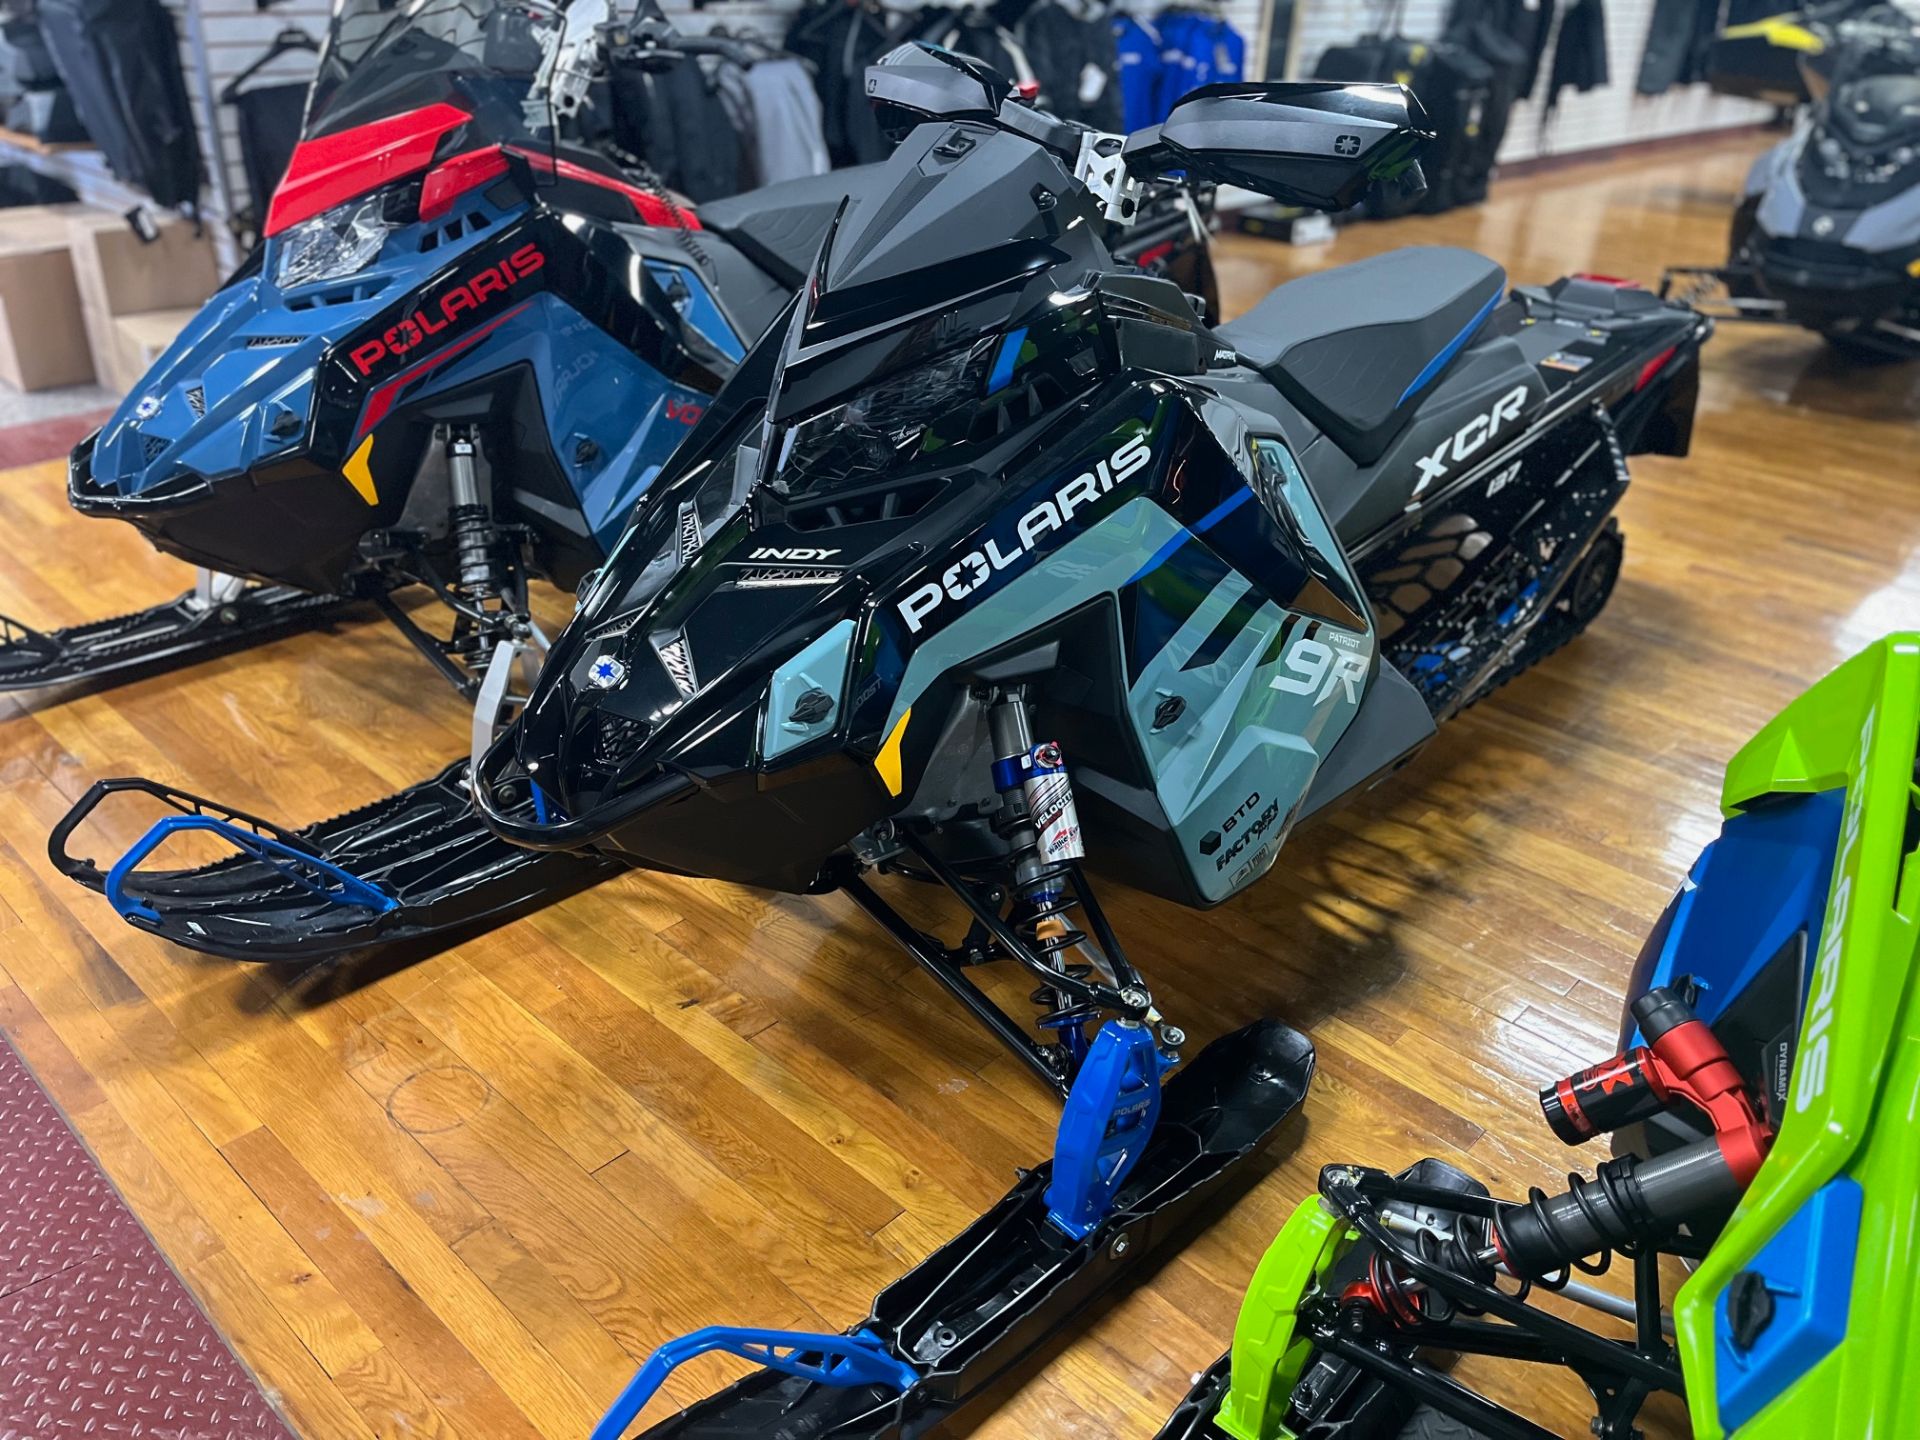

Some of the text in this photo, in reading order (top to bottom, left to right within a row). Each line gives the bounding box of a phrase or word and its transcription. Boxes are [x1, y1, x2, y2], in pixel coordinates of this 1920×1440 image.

[350, 242, 545, 376] POLARIS
[1411, 385, 1528, 497] XCR
[748, 547, 842, 560] INDY
[896, 433, 1152, 634] POLARIS
[1268, 638, 1371, 707] 9R
[1328, 631, 1361, 648] PATRIOT
[1215, 797, 1279, 872] FACTORY
[1222, 791, 1261, 834] BTD
[1796, 703, 1876, 1113] POLARIS
[1776, 1042, 1788, 1102] DYNAMIX
